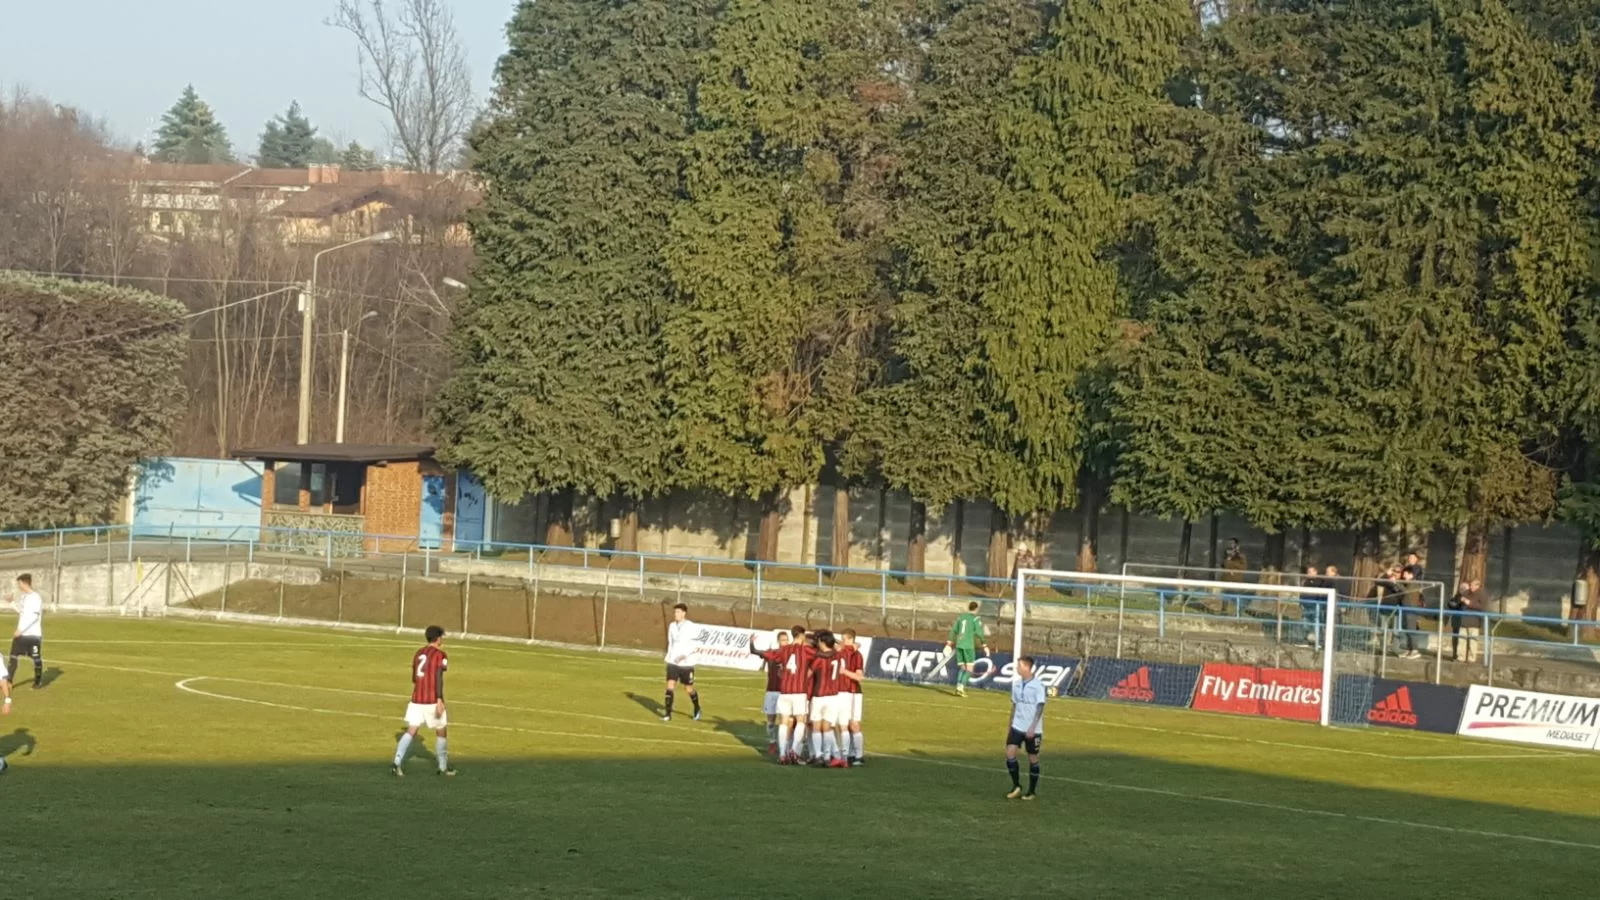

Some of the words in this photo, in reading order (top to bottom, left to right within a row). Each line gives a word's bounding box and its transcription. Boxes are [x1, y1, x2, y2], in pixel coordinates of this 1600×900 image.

[416, 653, 427, 677] 2
[786, 653, 797, 674] 4
[879, 647, 955, 680] GKFX
[1109, 687, 1155, 702] adidas
[1200, 675, 1233, 701] Fly
[1236, 678, 1322, 705] Emirates
[1367, 708, 1418, 726] adidas
[1546, 729, 1592, 743] MEDIASET
